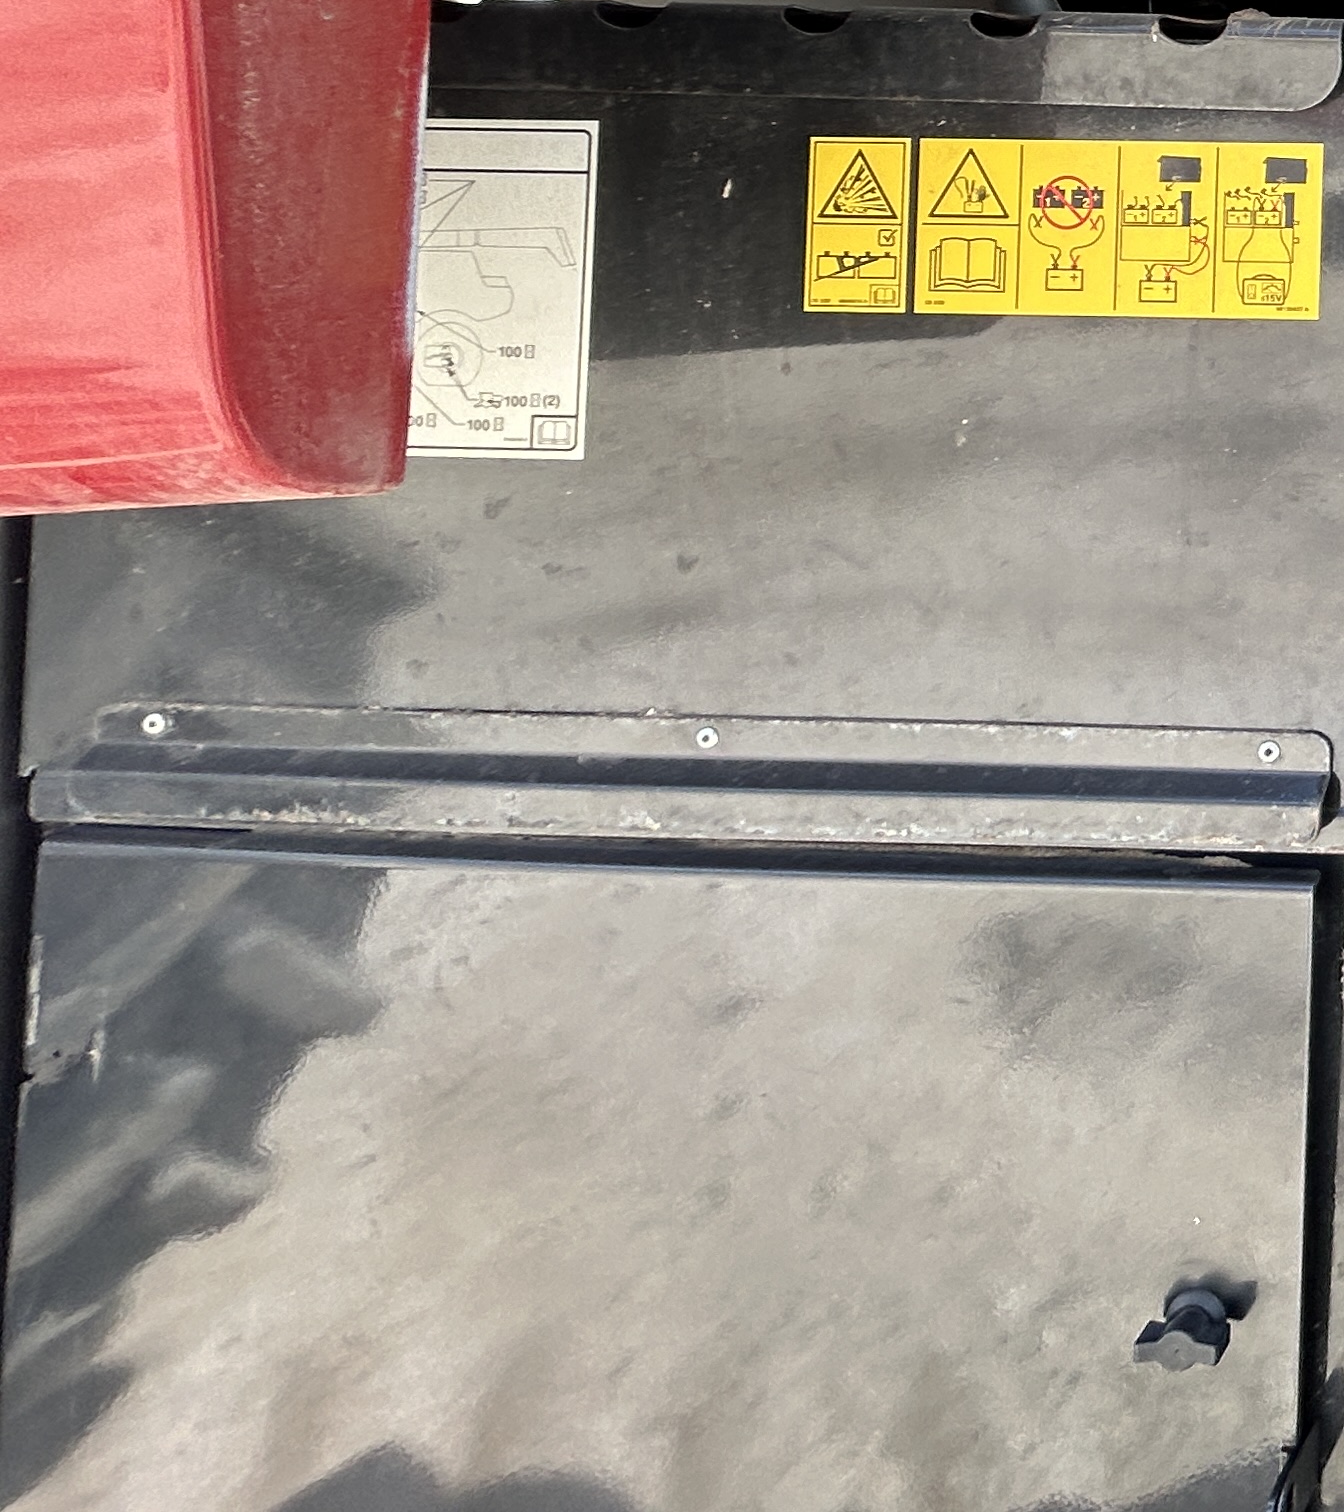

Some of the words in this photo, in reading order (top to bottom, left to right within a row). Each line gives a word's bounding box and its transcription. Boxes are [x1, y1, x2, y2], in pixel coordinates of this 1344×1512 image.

[498, 345, 523, 359] 100
[503, 395, 528, 408] 100
[542, 394, 561, 410] (2)
[467, 419, 491, 432] 100
